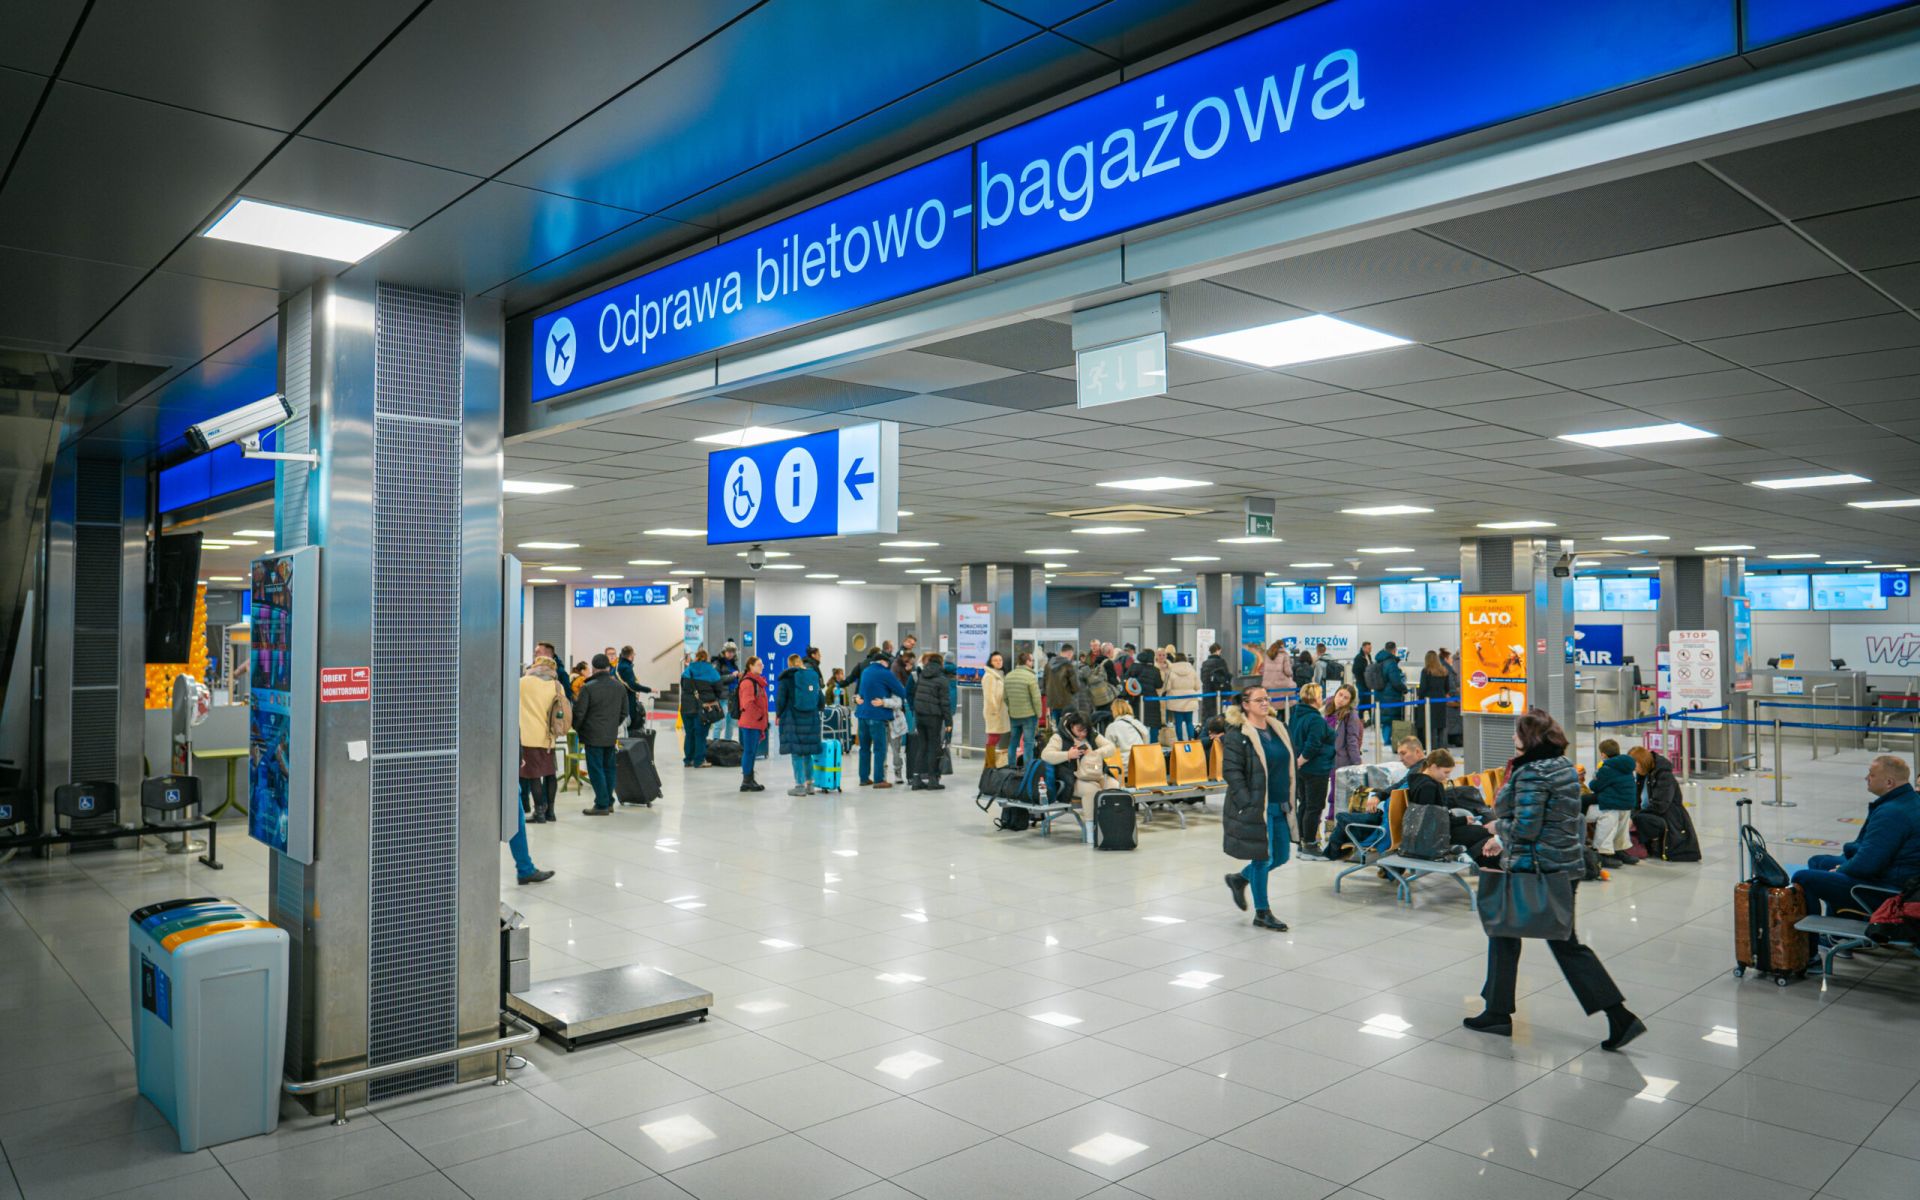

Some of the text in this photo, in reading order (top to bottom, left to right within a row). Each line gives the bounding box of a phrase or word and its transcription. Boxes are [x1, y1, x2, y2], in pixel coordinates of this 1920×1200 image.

[598, 269, 743, 354] Odprawa
[1893, 579, 1907, 596] 9
[1183, 595, 1190, 607] 1
[1310, 591, 1318, 604] 3
[1343, 590, 1352, 604] 4
[1469, 611, 1512, 625] LATO
[1304, 634, 1348, 647] RZESZÓW
[1679, 631, 1708, 639] STOP
[323, 673, 347, 683] OBIEKT
[767, 652, 776, 703] WINDA
[323, 686, 369, 697] MONITOROWANY
